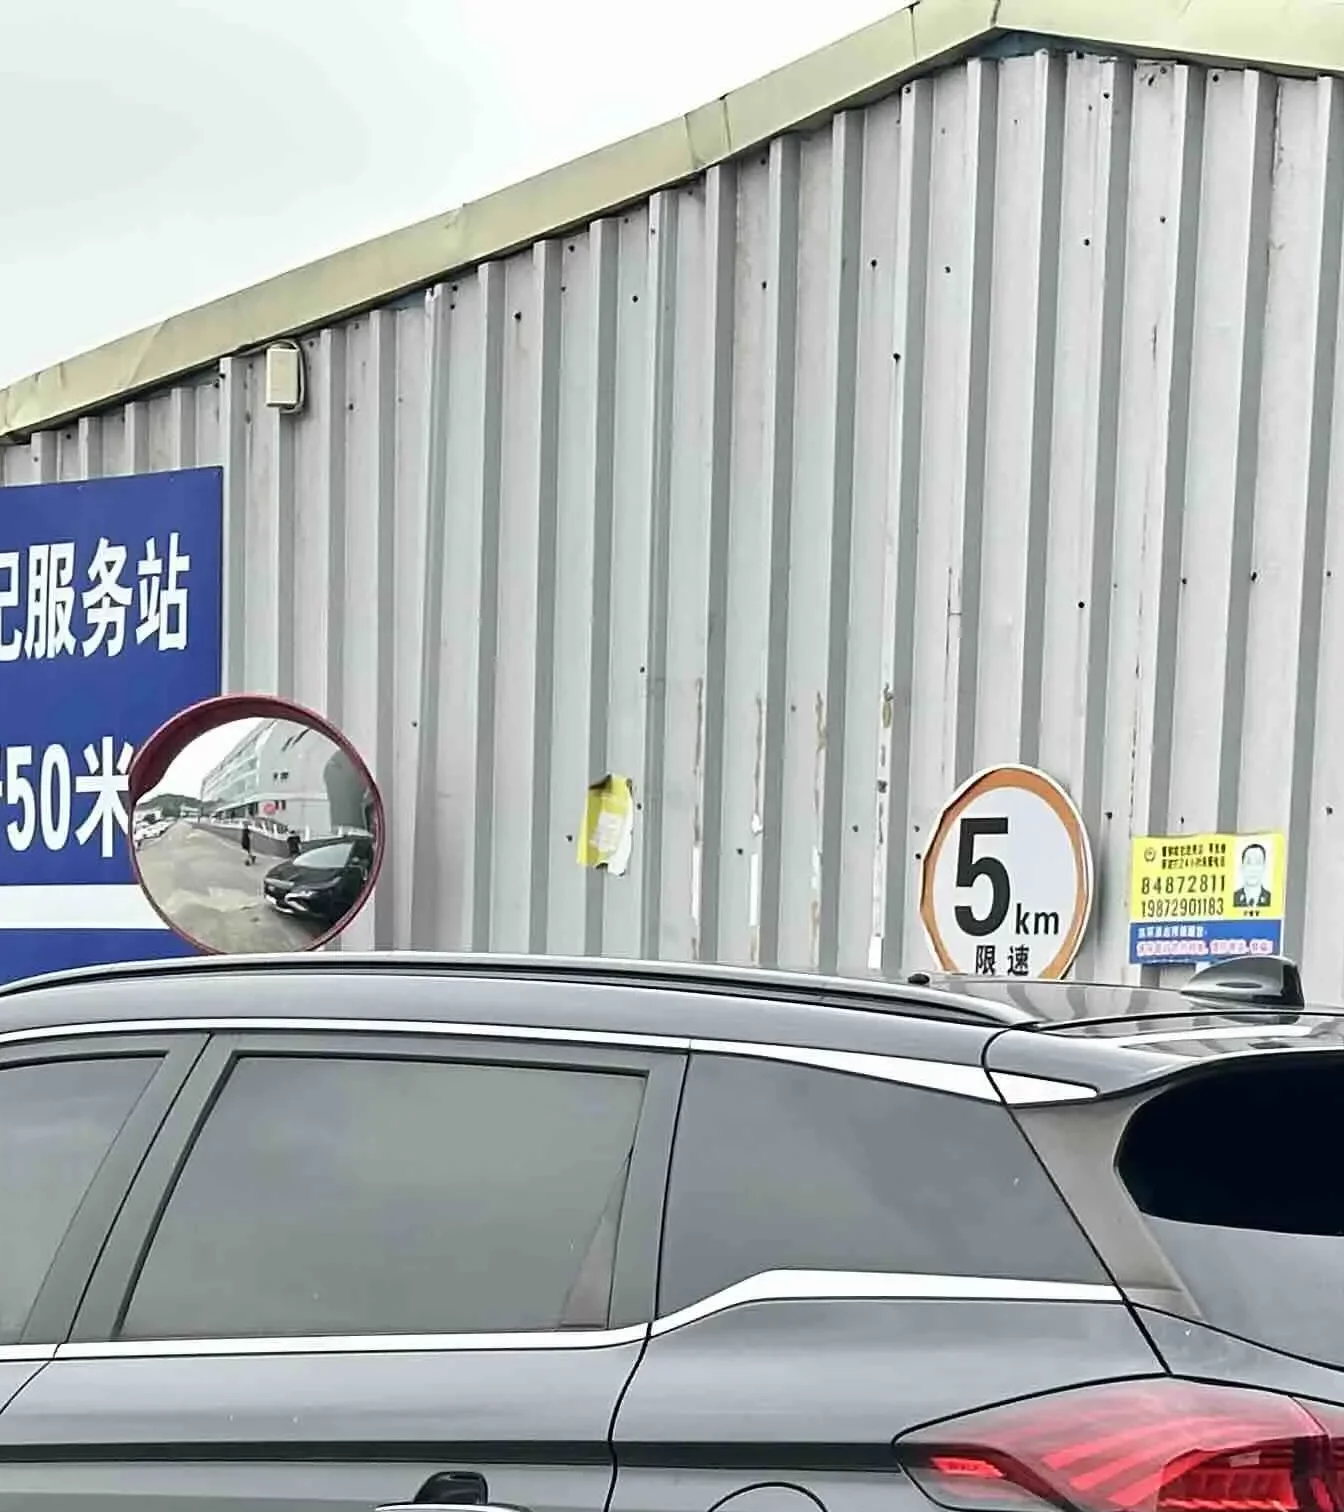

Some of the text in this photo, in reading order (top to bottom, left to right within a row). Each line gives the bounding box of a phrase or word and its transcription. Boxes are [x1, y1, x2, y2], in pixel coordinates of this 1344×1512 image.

[955, 817, 1059, 936] 5 km
[1141, 874, 1226, 895] 84872811
[1140, 897, 1225, 918] 19872901183
[975, 943, 1030, 976] 限速
